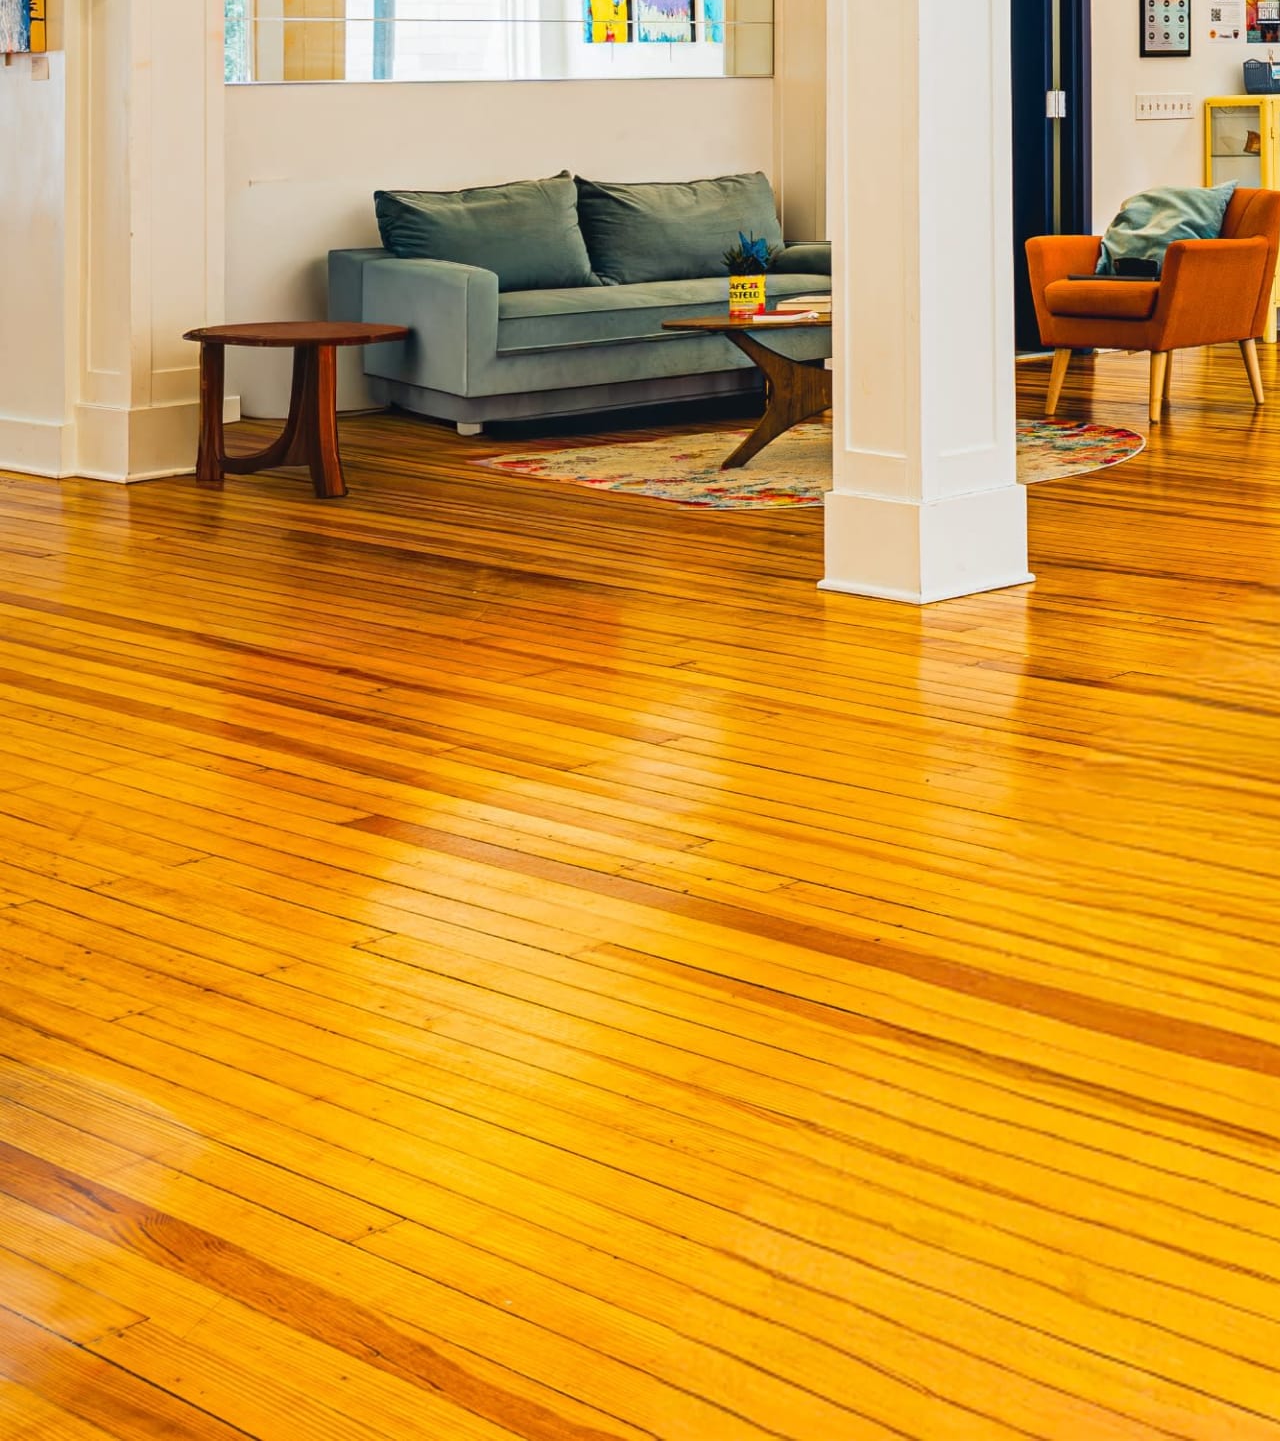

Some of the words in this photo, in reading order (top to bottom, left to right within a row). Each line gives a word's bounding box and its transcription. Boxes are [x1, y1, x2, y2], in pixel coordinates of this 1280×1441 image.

[1258, 8, 1279, 20] RENTAL
[729, 282, 747, 291] AFE
[729, 291, 760, 299] STELO
